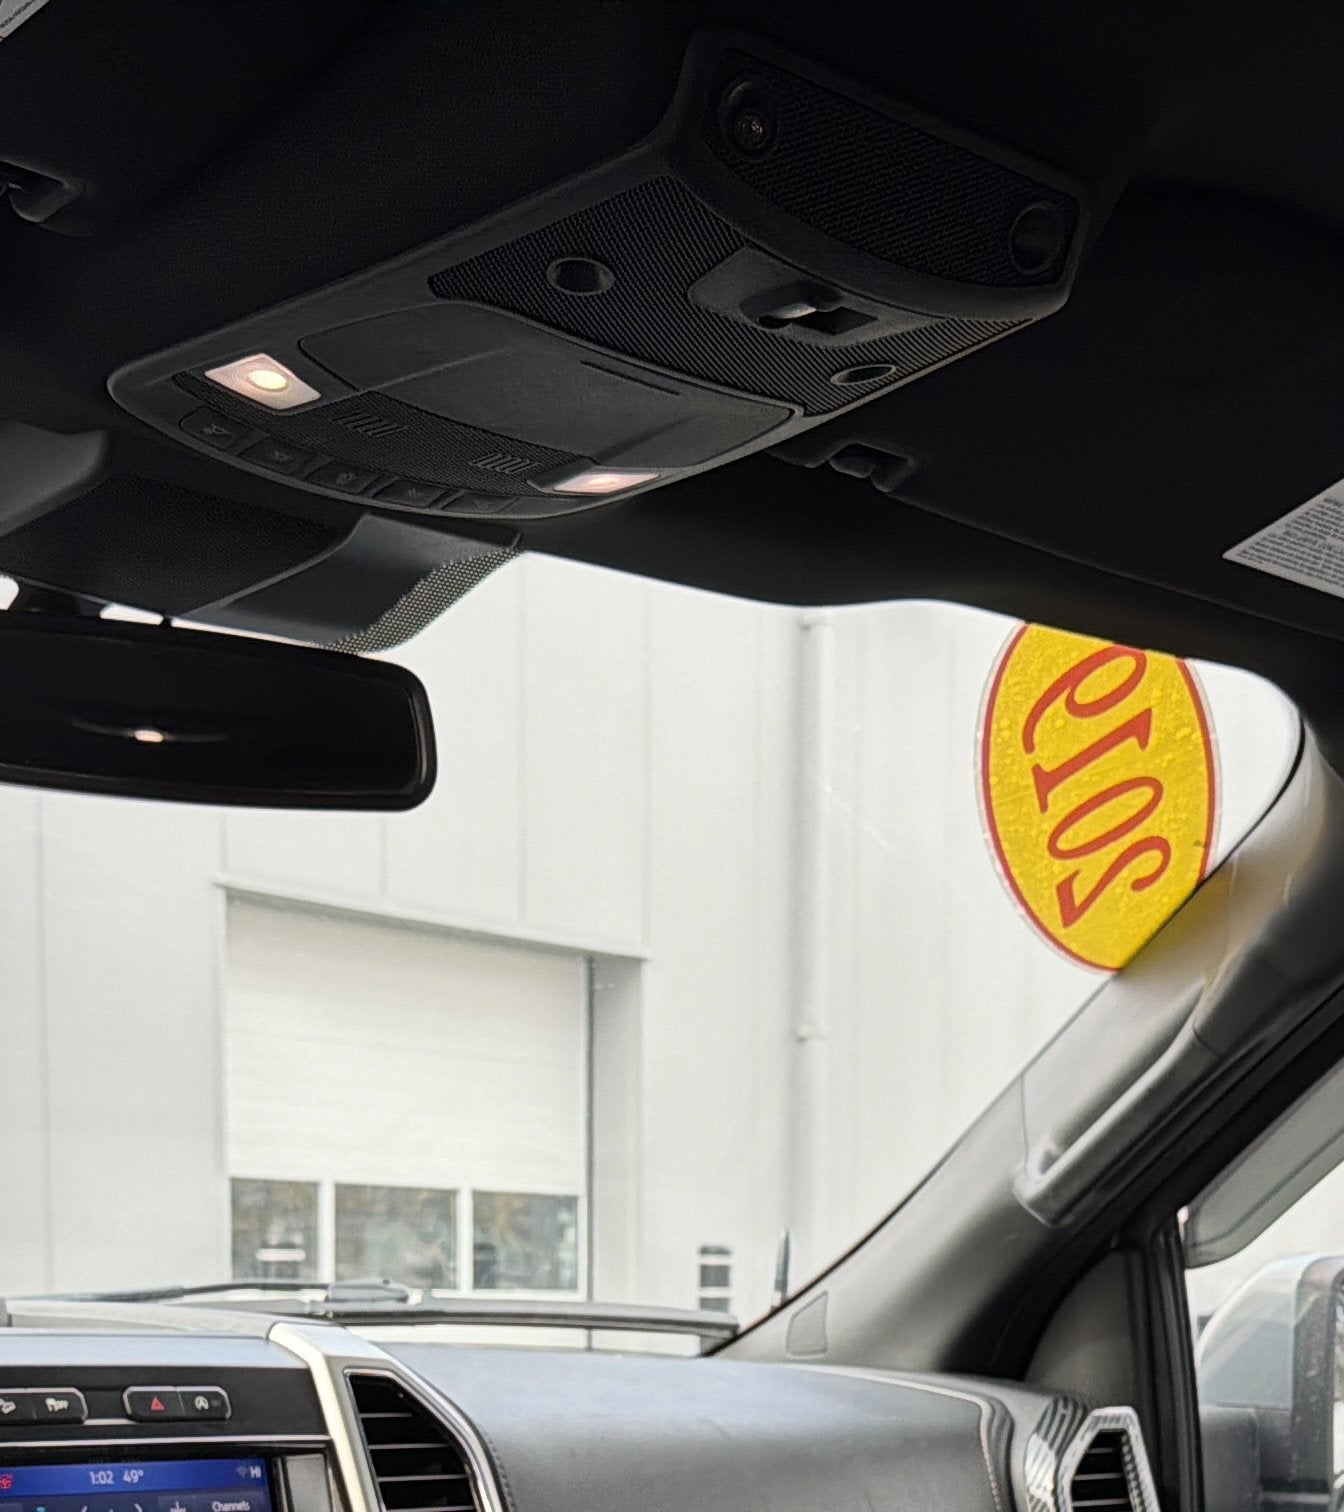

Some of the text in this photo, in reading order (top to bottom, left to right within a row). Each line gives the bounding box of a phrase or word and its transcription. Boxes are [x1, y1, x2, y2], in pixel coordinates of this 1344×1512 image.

[89, 1469, 144, 1485] 1:02 49°
[249, 1466, 262, 1479] HI
